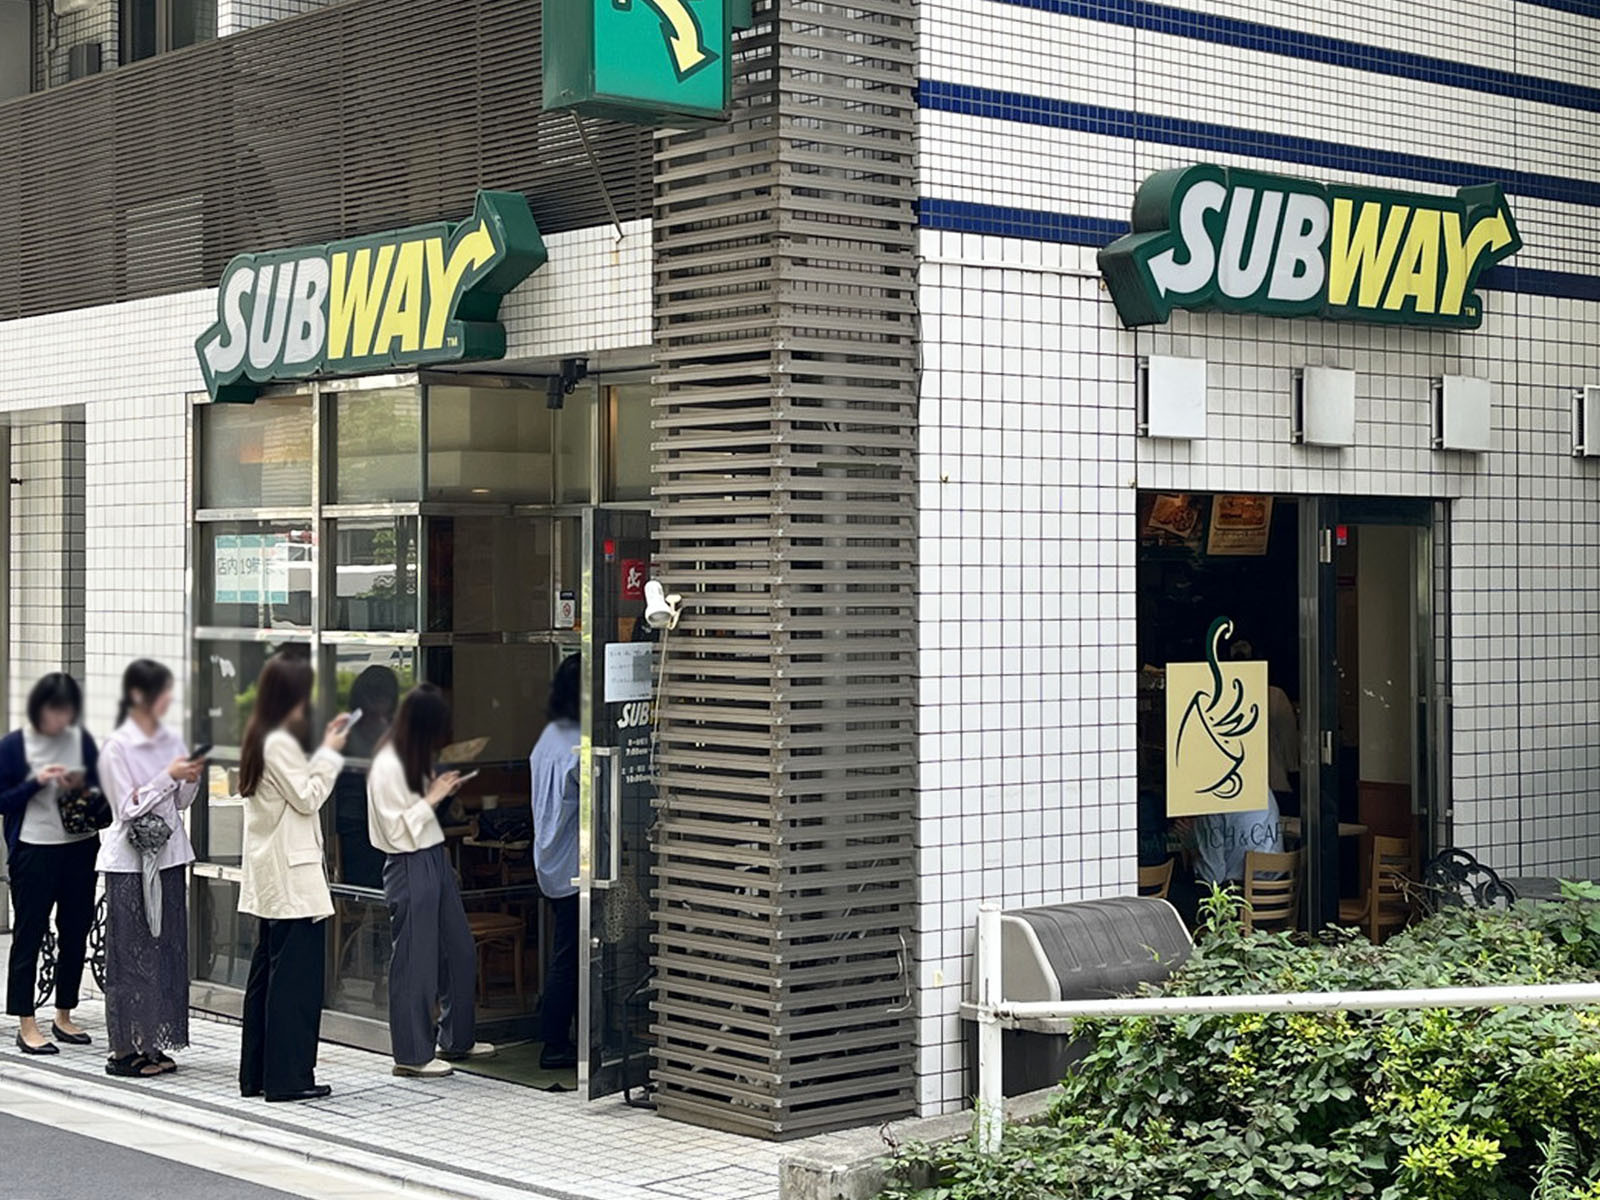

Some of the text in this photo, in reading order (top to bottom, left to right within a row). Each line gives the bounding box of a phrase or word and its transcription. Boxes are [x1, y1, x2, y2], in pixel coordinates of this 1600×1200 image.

[203, 218, 496, 378] SUBWAY
[1146, 180, 1512, 316] SUBWAY
[617, 702, 657, 728] SUB
